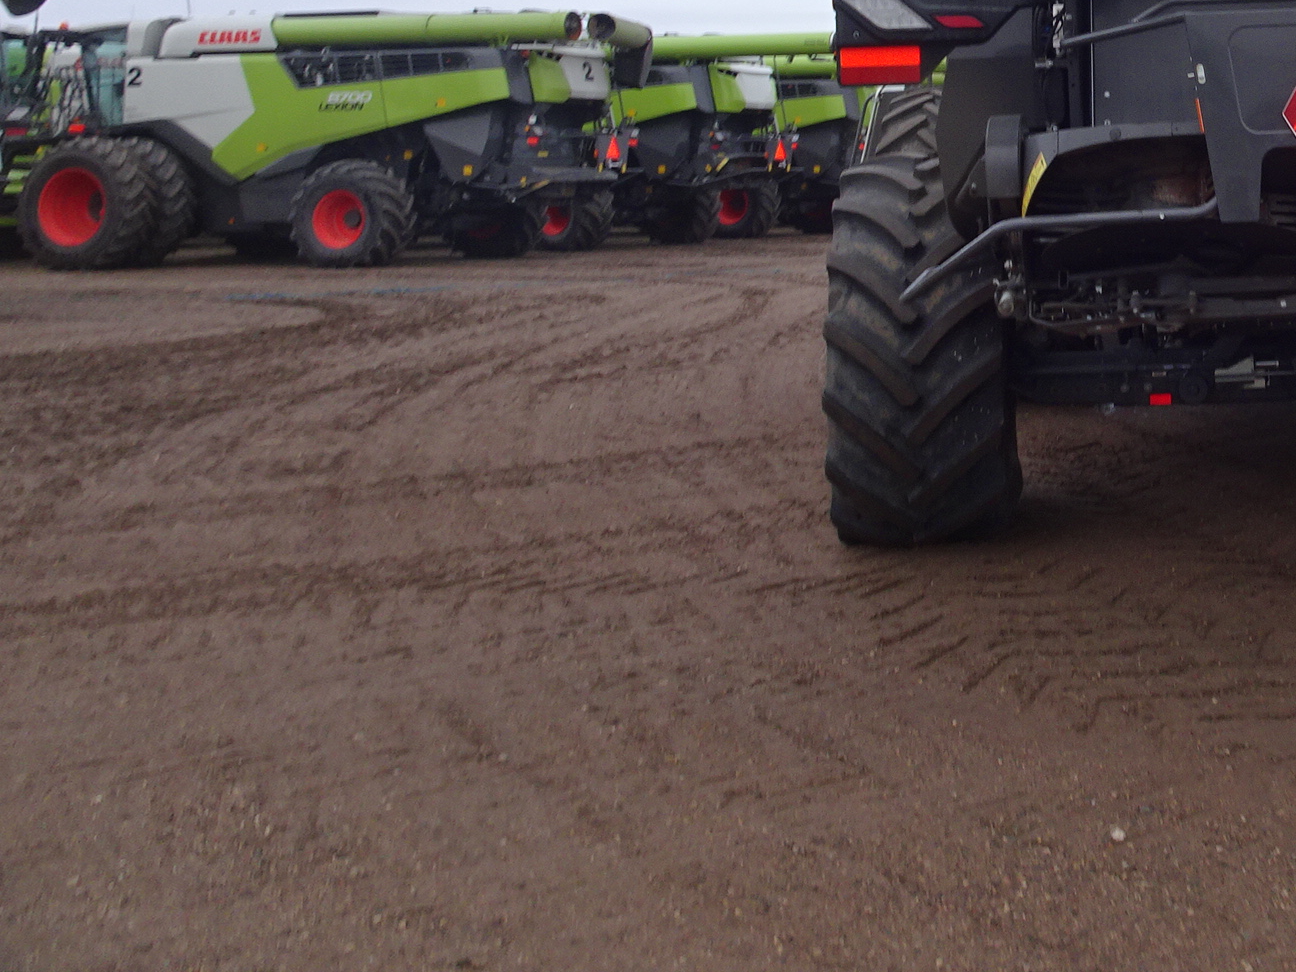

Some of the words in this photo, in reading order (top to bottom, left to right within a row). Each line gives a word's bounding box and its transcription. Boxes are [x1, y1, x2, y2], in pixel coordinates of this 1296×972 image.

[197, 28, 262, 46] CLAAS
[127, 67, 143, 87] 2
[582, 60, 595, 82] 2
